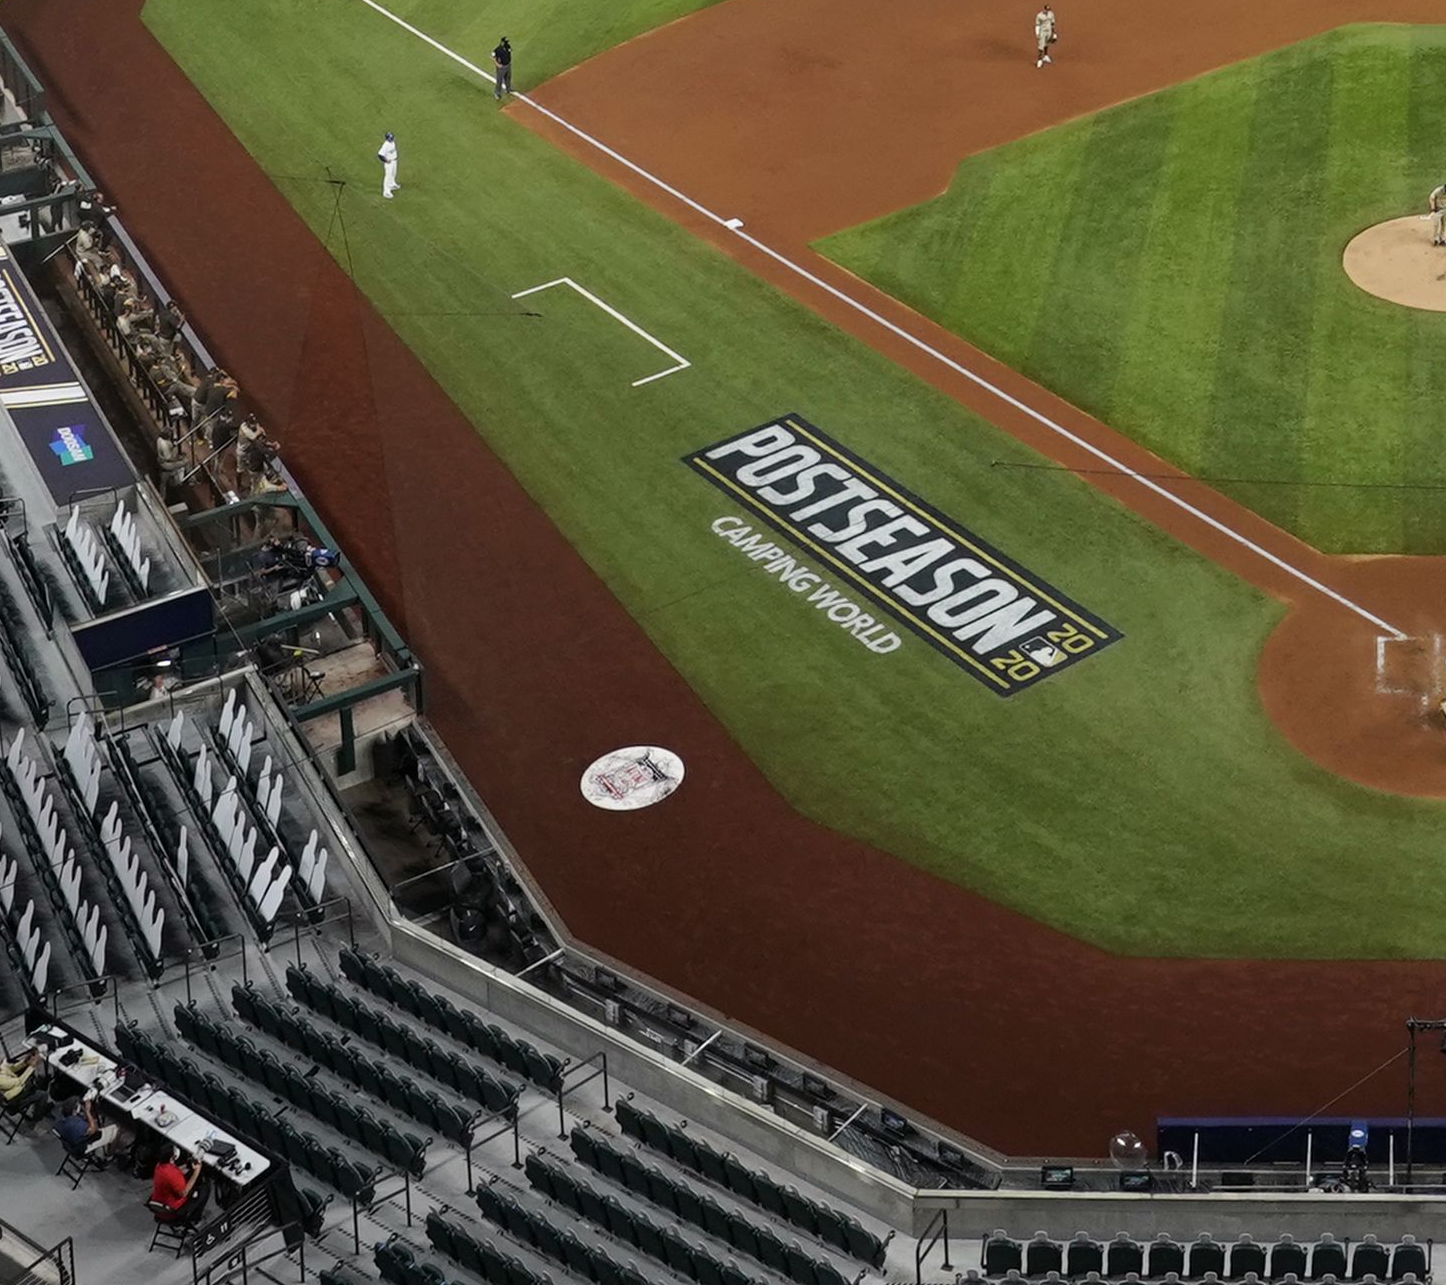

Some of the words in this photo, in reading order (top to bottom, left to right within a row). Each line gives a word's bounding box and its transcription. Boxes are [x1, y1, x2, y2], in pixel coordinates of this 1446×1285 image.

[705, 424, 1056, 655] POSTSEASON
[710, 514, 821, 592] CAMPING
[807, 584, 903, 655] WORLD
[991, 651, 1040, 682] 20
[1049, 623, 1094, 654] 20
